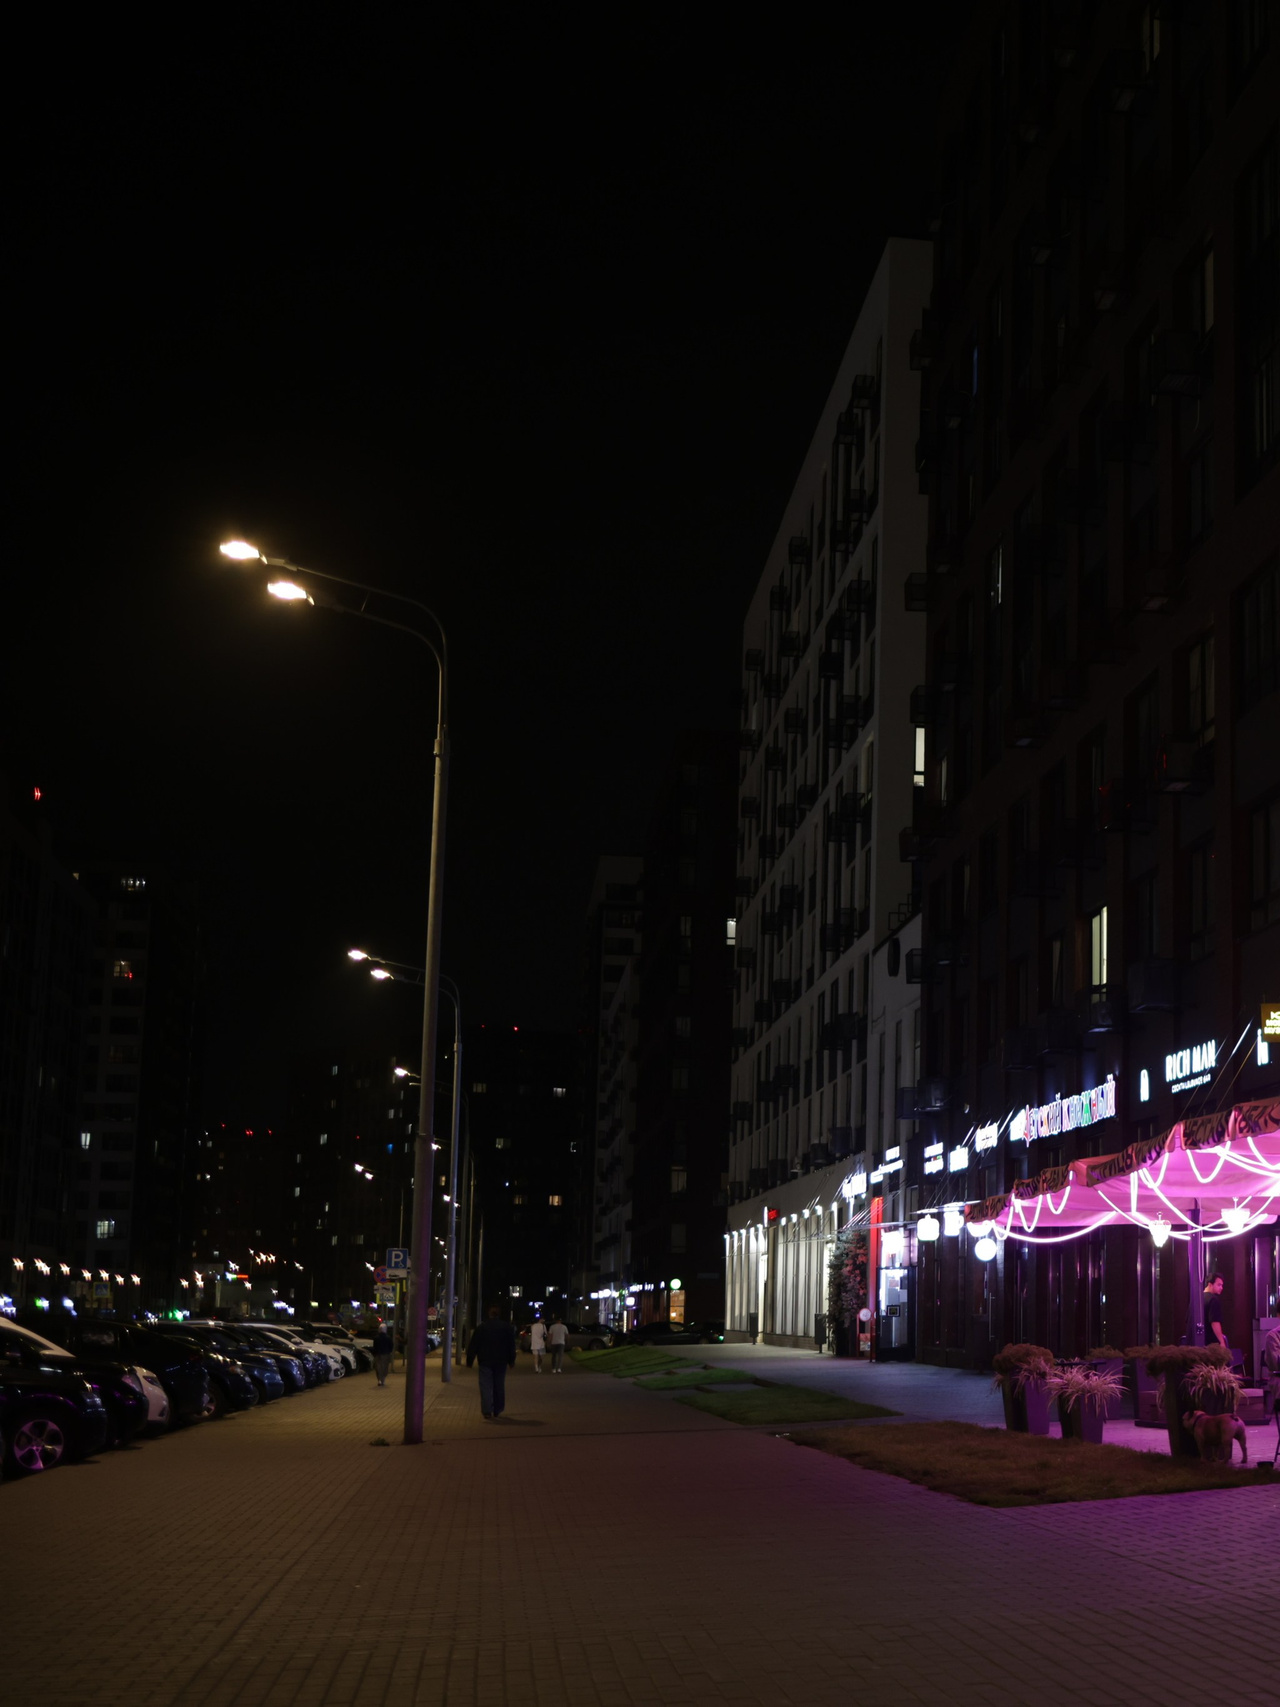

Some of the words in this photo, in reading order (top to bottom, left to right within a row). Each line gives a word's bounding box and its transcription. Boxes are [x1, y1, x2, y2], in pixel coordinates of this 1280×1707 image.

[1165, 1048, 1190, 1082] RICH
[1192, 1039, 1216, 1073] MAN
[1024, 1092, 1062, 1148] ДЕТСКИЙ
[1061, 1073, 1116, 1132] КНИЖНЫЙ
